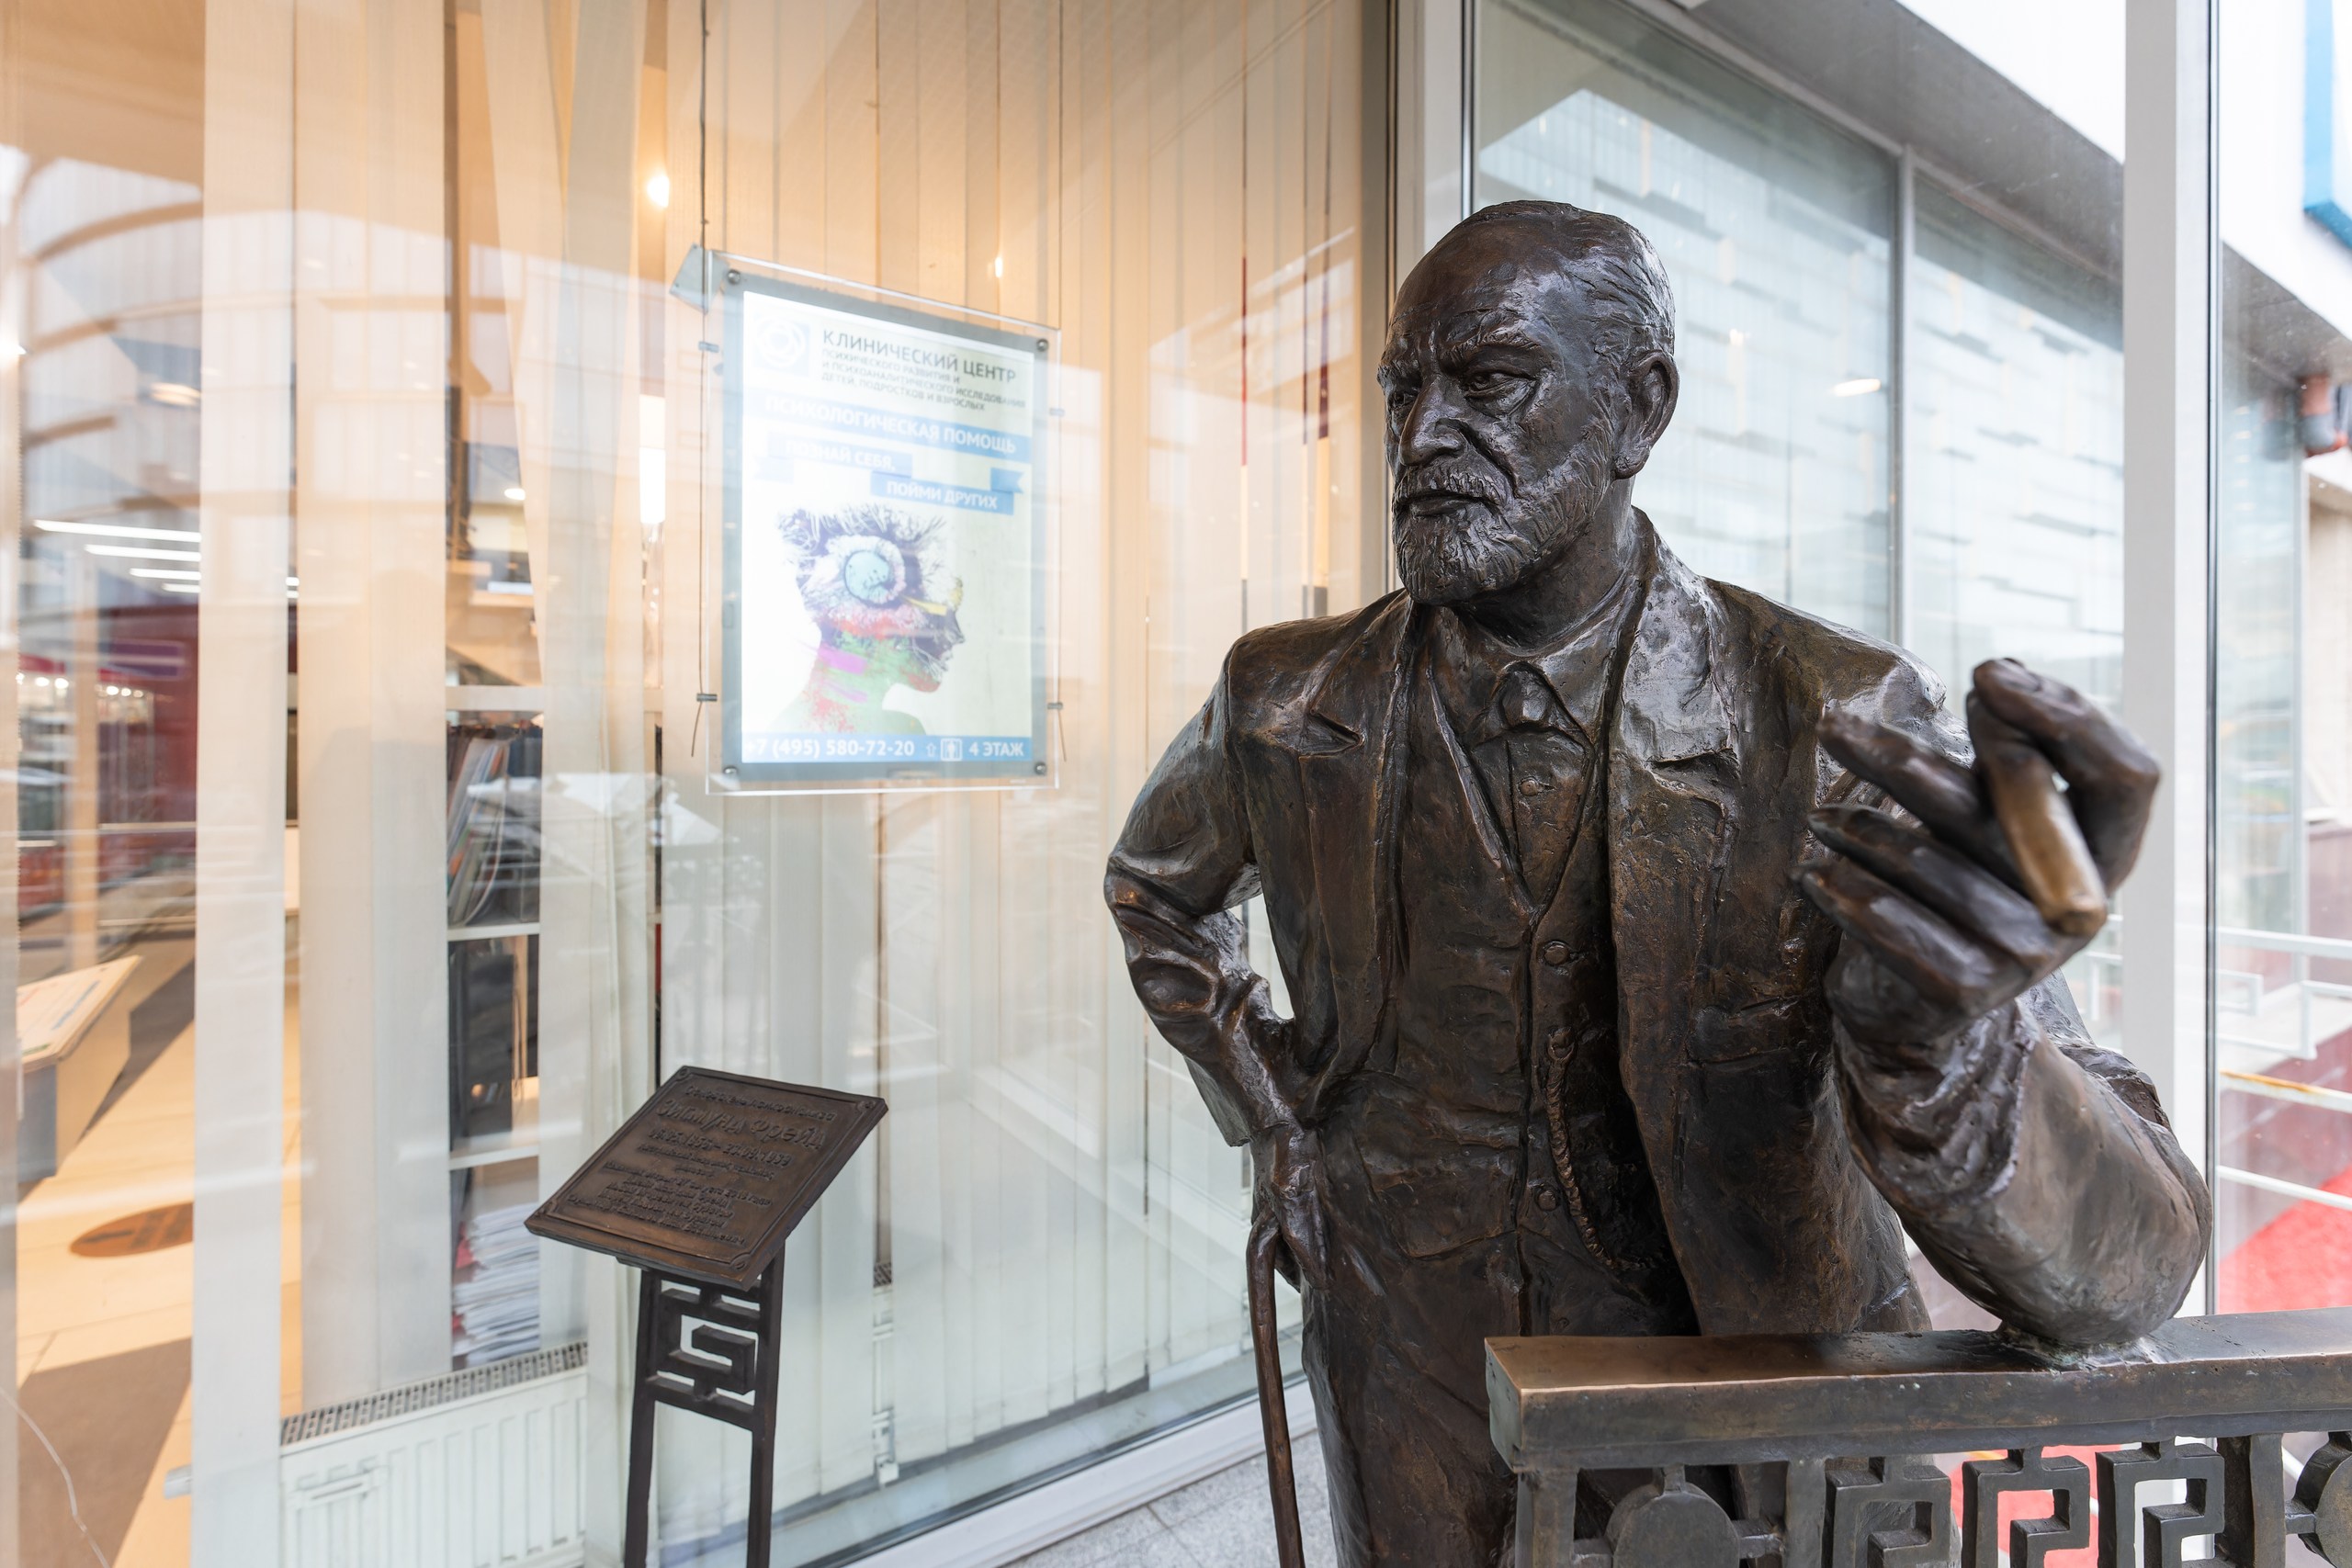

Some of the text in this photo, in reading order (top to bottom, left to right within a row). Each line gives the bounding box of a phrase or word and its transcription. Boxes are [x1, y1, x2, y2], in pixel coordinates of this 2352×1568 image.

[822, 328, 1017, 384] КЛИНИЧЕСКИЙ ЦЕНТР
[822, 349, 901, 371] ПСИХИЧЕСКОГО
[953, 375, 960, 383] И
[822, 361, 829, 369] И
[831, 362, 953, 393] ПСИХОАНАЛИТИЧЕСКОГО
[859, 378, 924, 400] ПОДРОСТКОВ
[926, 391, 933, 400] И
[936, 393, 985, 411] ВЗРОСЛЫХ
[764, 397, 1015, 454] ПСИХОЛОГИЧЕСКАЯ ПОМОЩЬ
[786, 440, 852, 462] ПОЗНАЙ
[887, 479, 998, 509] ПОЙМИ ДРУГИХ
[773, 738, 820, 759] (495)
[826, 739, 915, 756] 580-72-20
[968, 744, 979, 756] 4
[983, 744, 1024, 757] ЭТАЖ
[752, 1118, 827, 1150] Фрейд
